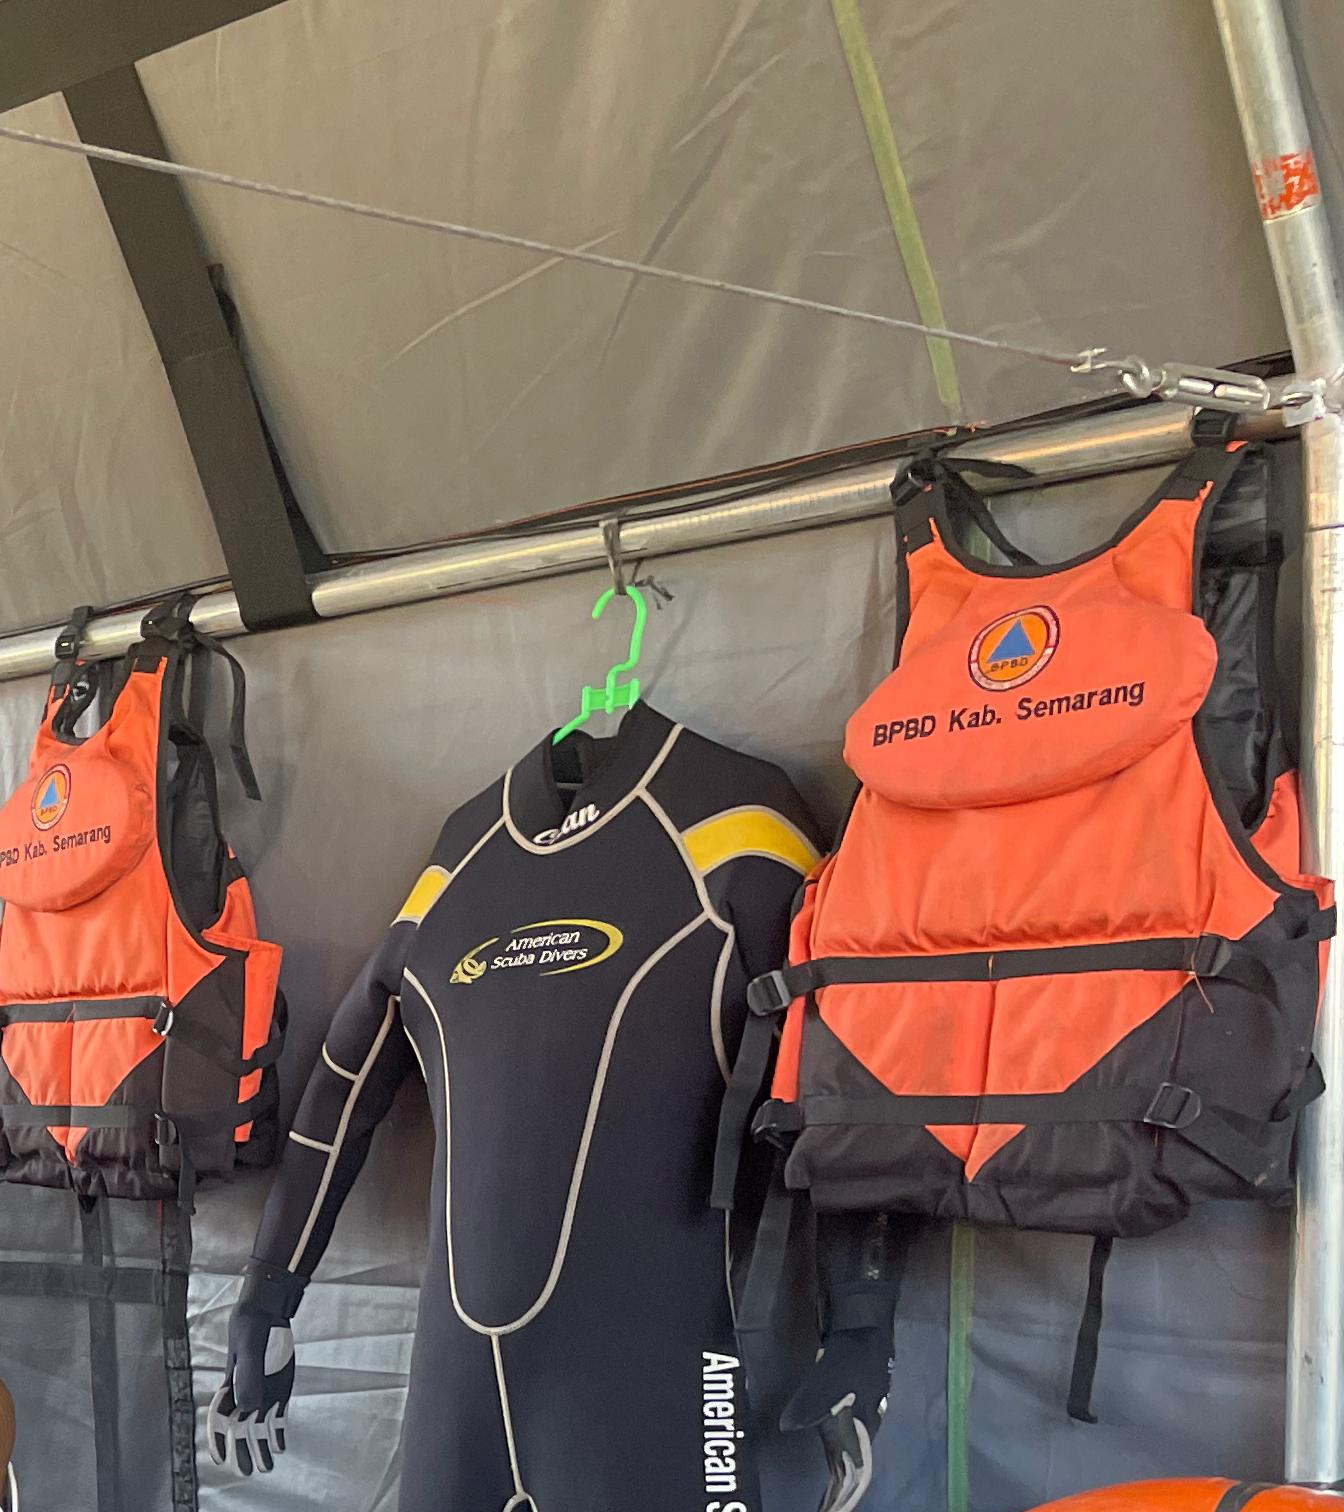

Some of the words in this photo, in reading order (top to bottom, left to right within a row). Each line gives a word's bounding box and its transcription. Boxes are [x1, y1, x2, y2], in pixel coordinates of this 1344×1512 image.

[872, 715, 937, 747] BPBD
[948, 704, 1002, 733] Kab.
[1016, 680, 1146, 721] Semarang
[24, 841, 48, 861] Kab.
[53, 825, 111, 853] Semarang
[490, 952, 535, 970] Scuba
[538, 947, 589, 965] Divers
[505, 930, 581, 952] American
[702, 1351, 745, 1493] American
